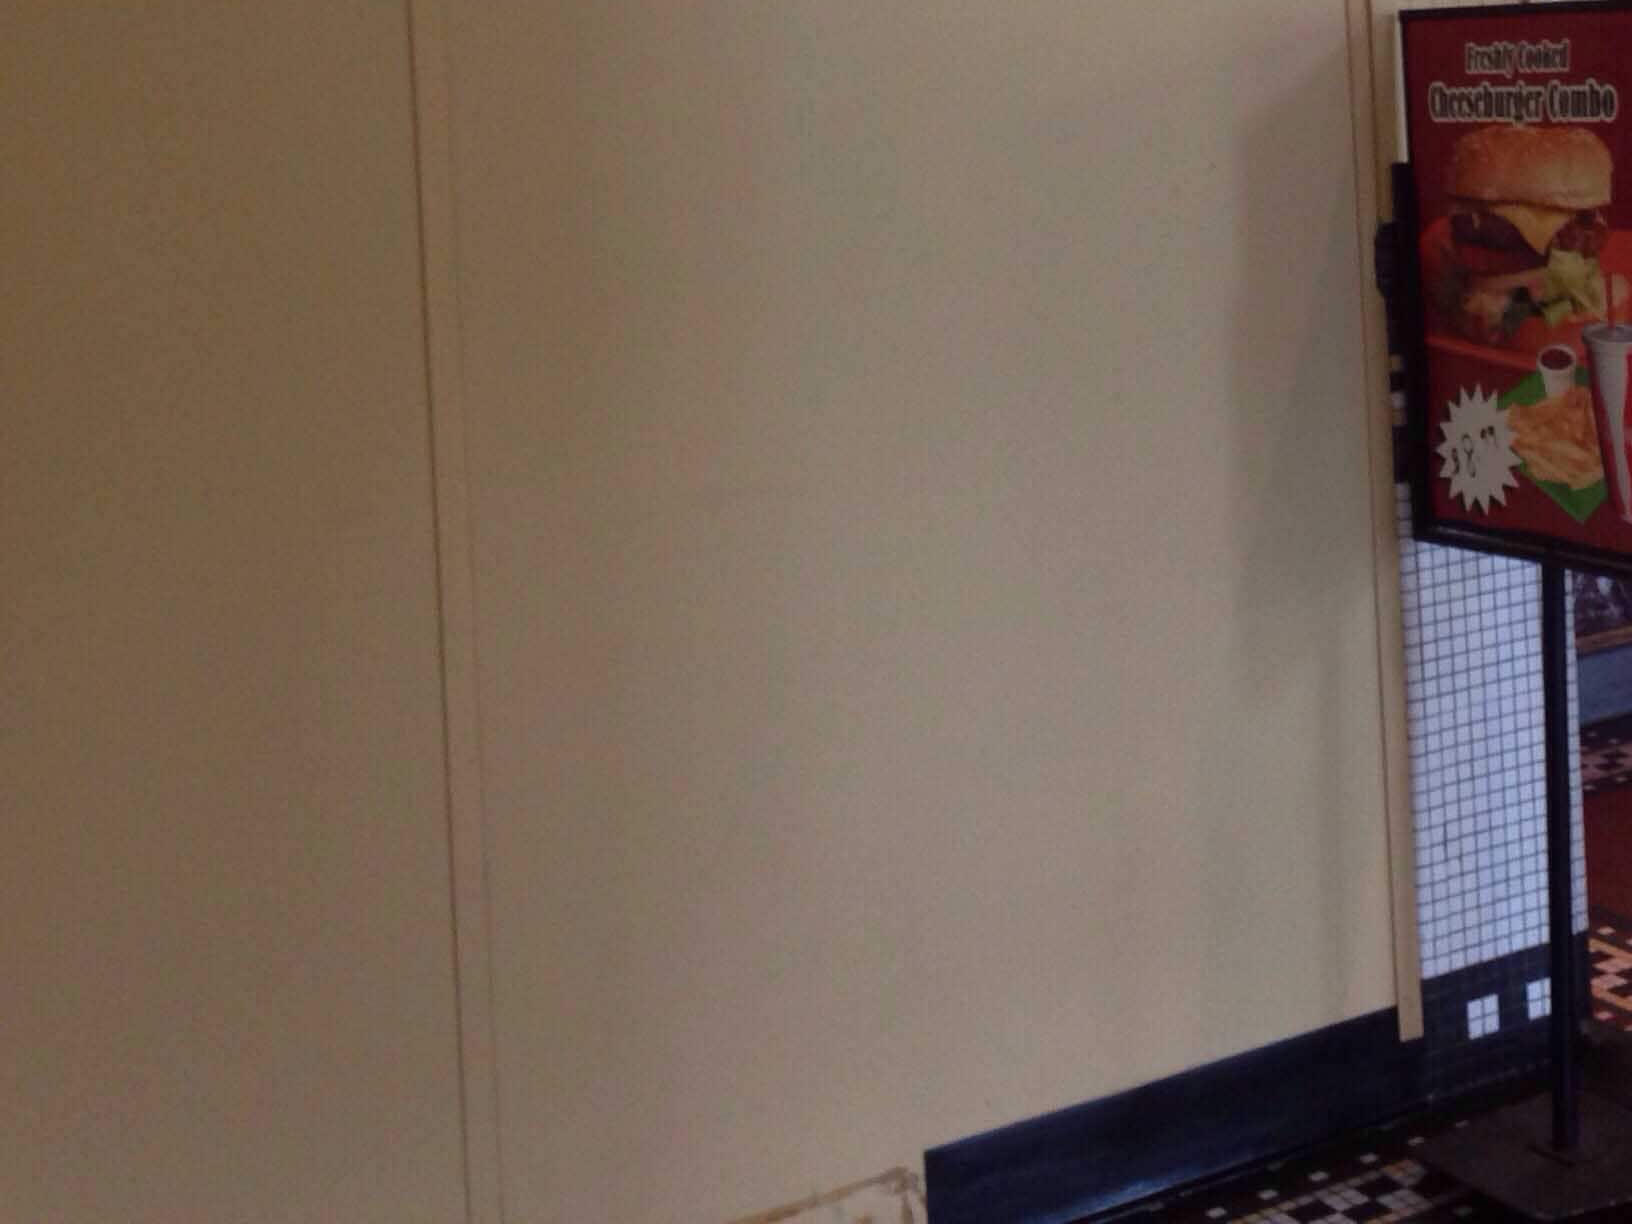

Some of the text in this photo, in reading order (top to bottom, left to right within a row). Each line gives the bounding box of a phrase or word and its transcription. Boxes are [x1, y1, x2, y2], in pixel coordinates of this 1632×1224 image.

[1518, 38, 1571, 72] Cooked
[1429, 78, 1619, 127] Cheeseburger Combo
